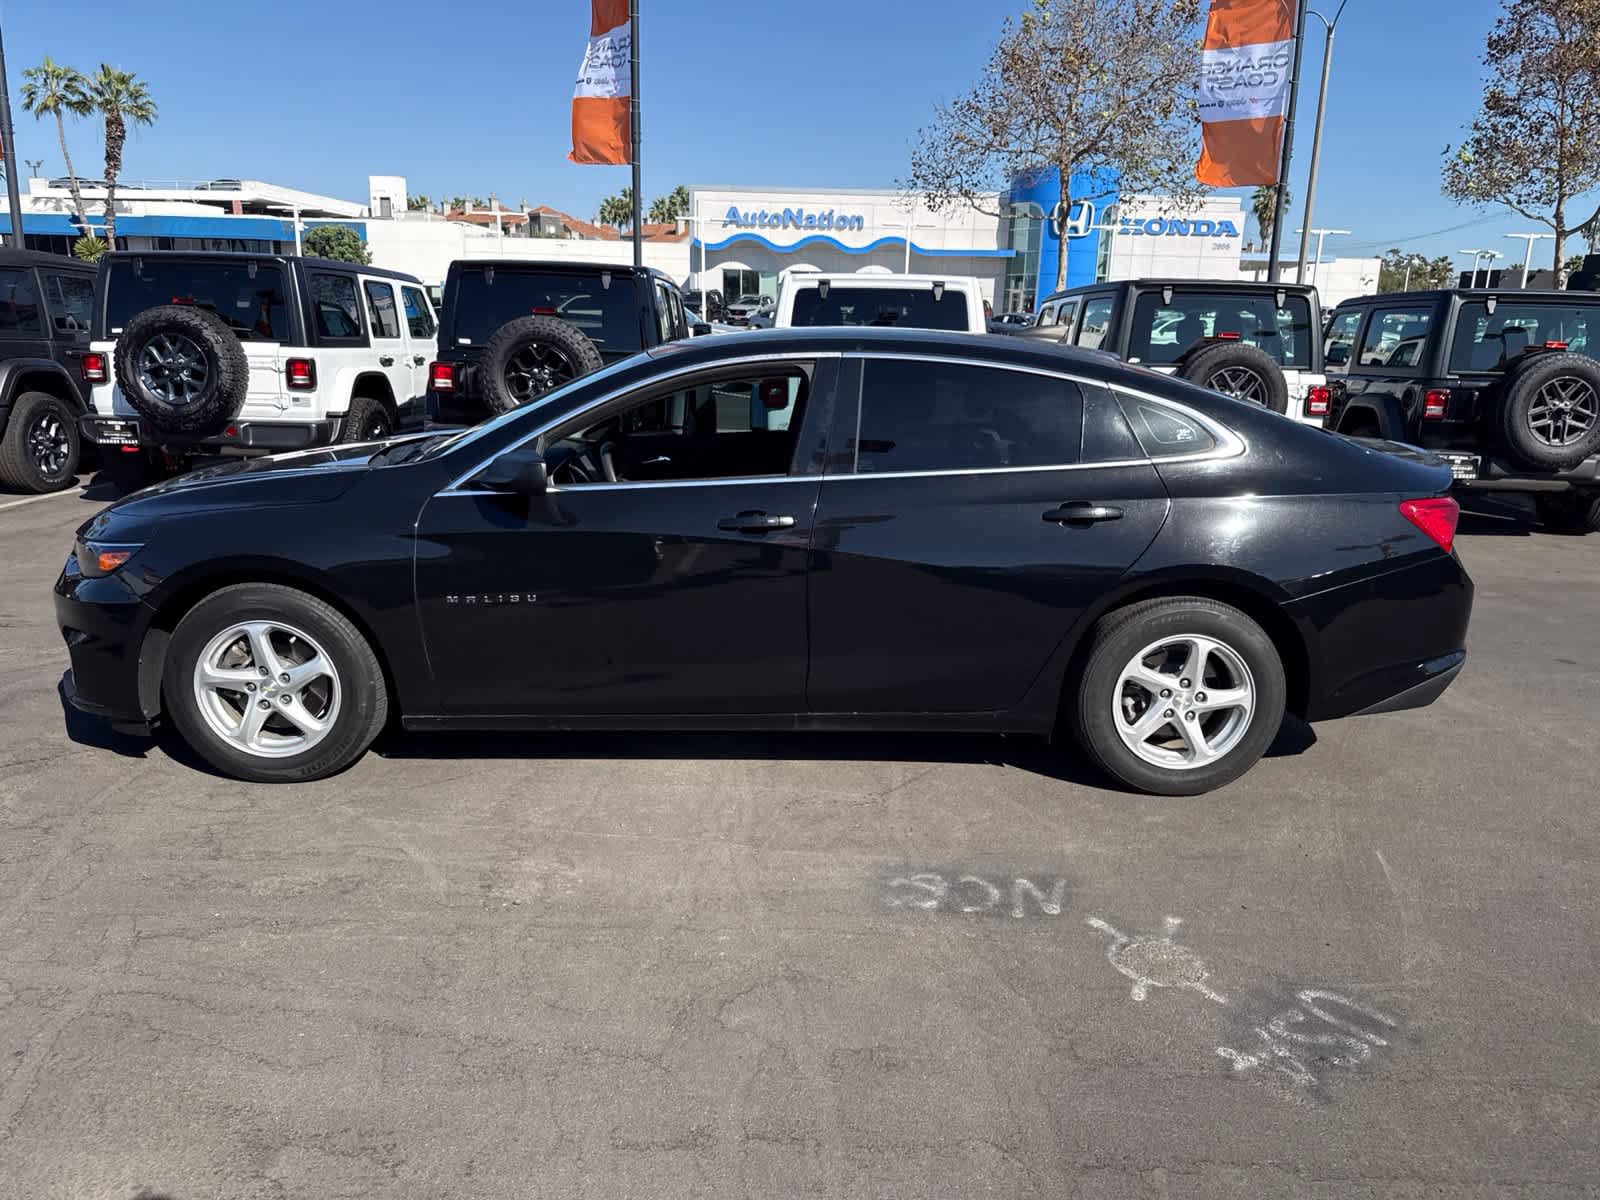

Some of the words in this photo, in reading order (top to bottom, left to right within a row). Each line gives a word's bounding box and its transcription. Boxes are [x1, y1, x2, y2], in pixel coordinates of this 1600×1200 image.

[722, 205, 865, 231] AutoNation
[1118, 216, 1240, 237] HONDA
[446, 594, 537, 603] MALIBU
